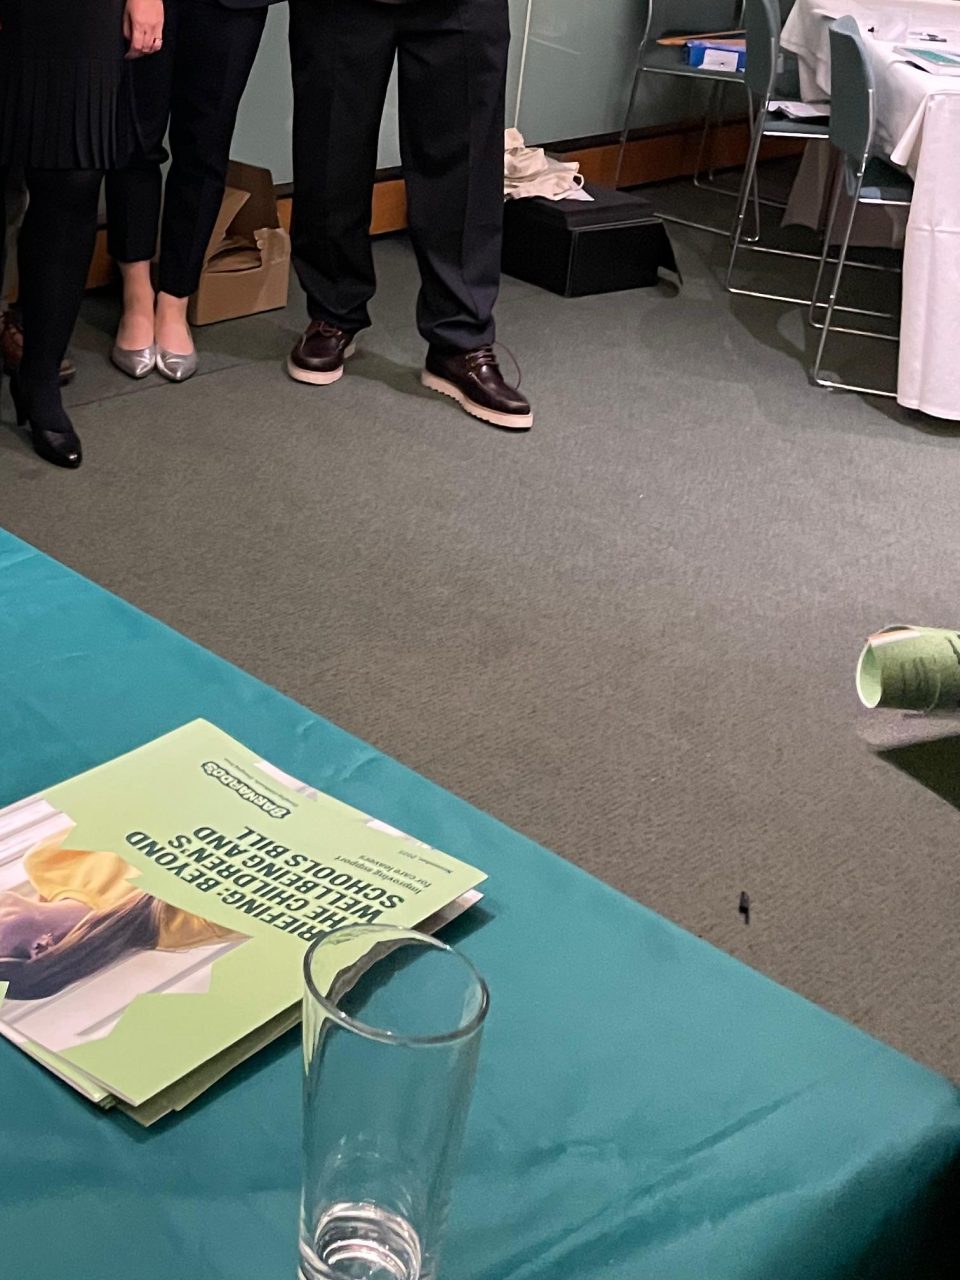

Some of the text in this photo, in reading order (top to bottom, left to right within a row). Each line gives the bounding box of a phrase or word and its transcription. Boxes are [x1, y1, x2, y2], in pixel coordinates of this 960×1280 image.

[203, 762, 289, 817] BARNARDO'S
[125, 831, 325, 942] RIEFING: BEYOND
[167, 834, 348, 930] HE CHILDREN'S
[193, 826, 384, 924] WELLBEING AND
[236, 826, 405, 909] SCHOOLS BILL
[334, 855, 422, 895] Improving support
[358, 854, 432, 888] for care leavers
